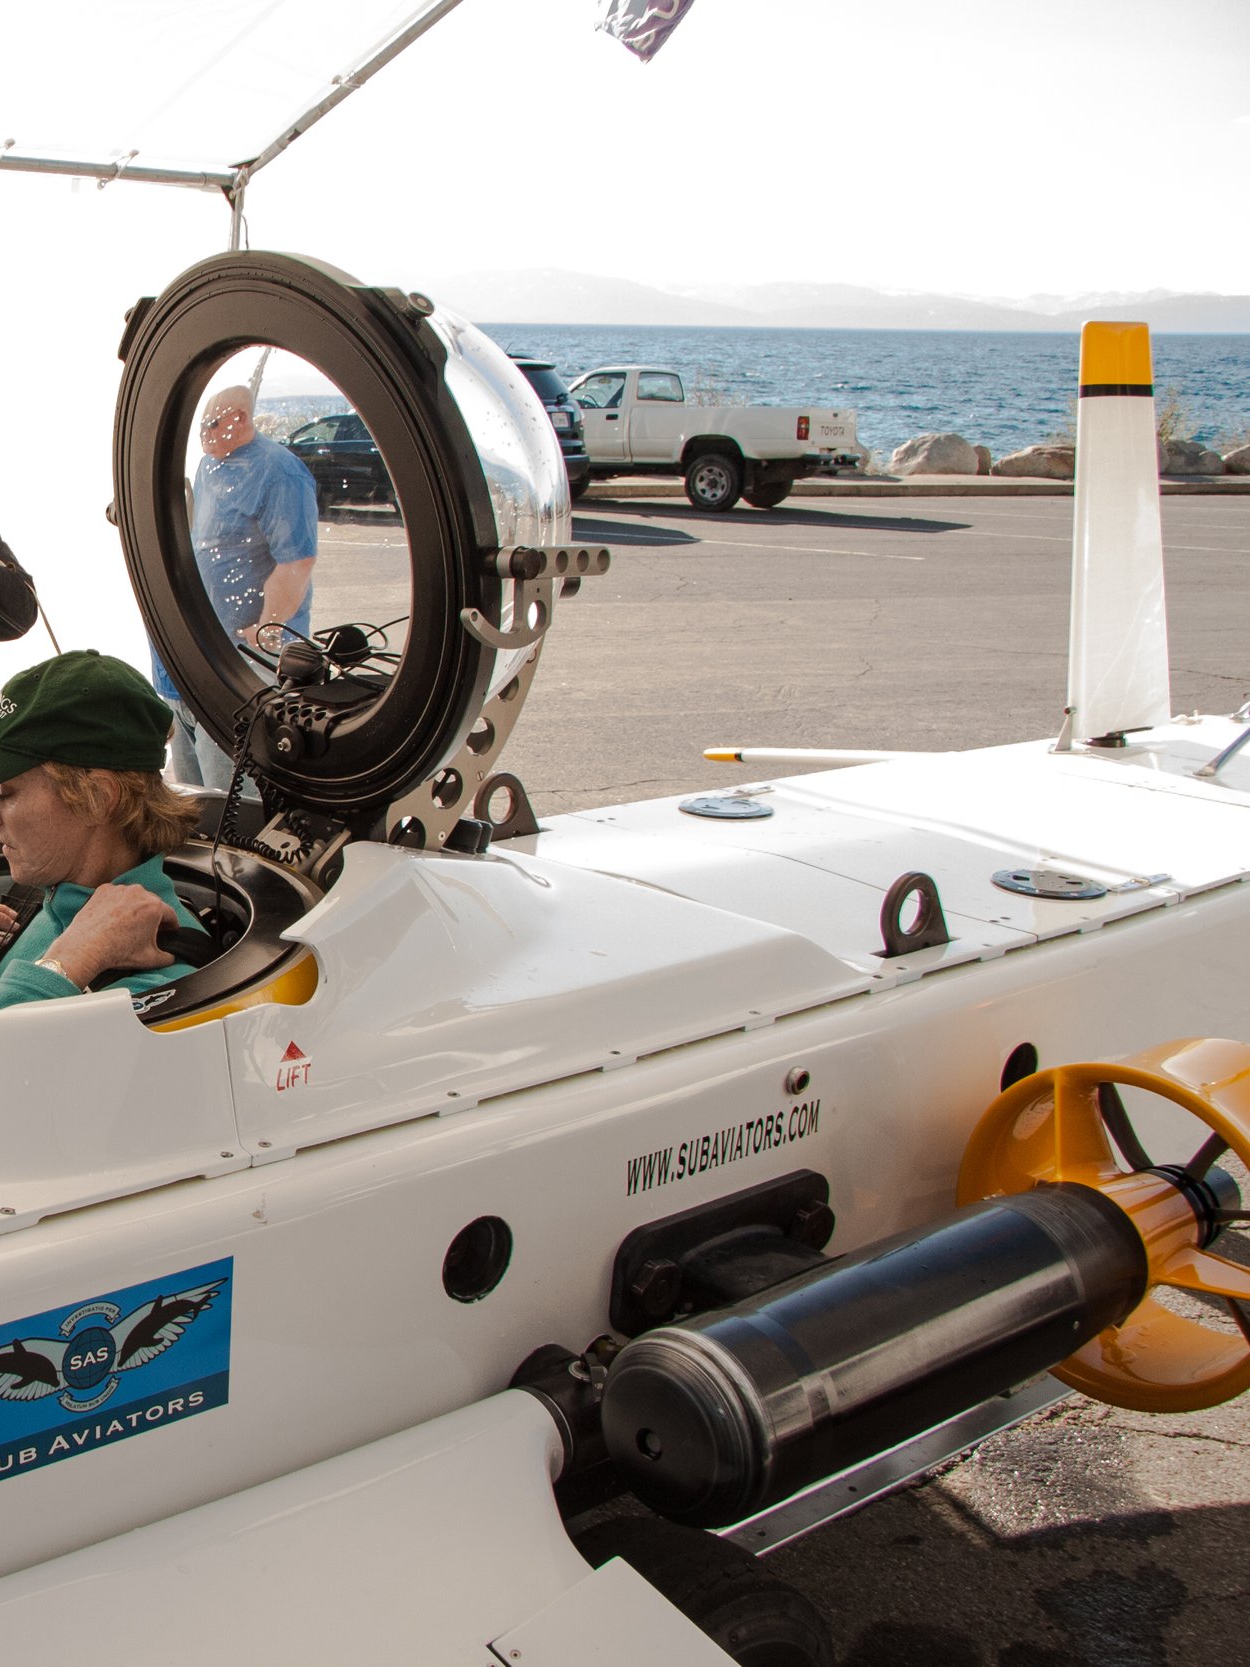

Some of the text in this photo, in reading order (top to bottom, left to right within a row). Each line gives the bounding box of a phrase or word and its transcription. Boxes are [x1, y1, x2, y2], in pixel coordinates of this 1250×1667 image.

[821, 425, 845, 436] TOYOTA
[276, 1063, 312, 1092] LIFT
[626, 1098, 821, 1197] WWW.SUBAVIATORS.COM
[69, 1346, 109, 1371] SAS
[48, 1391, 205, 1456] AVIATORS
